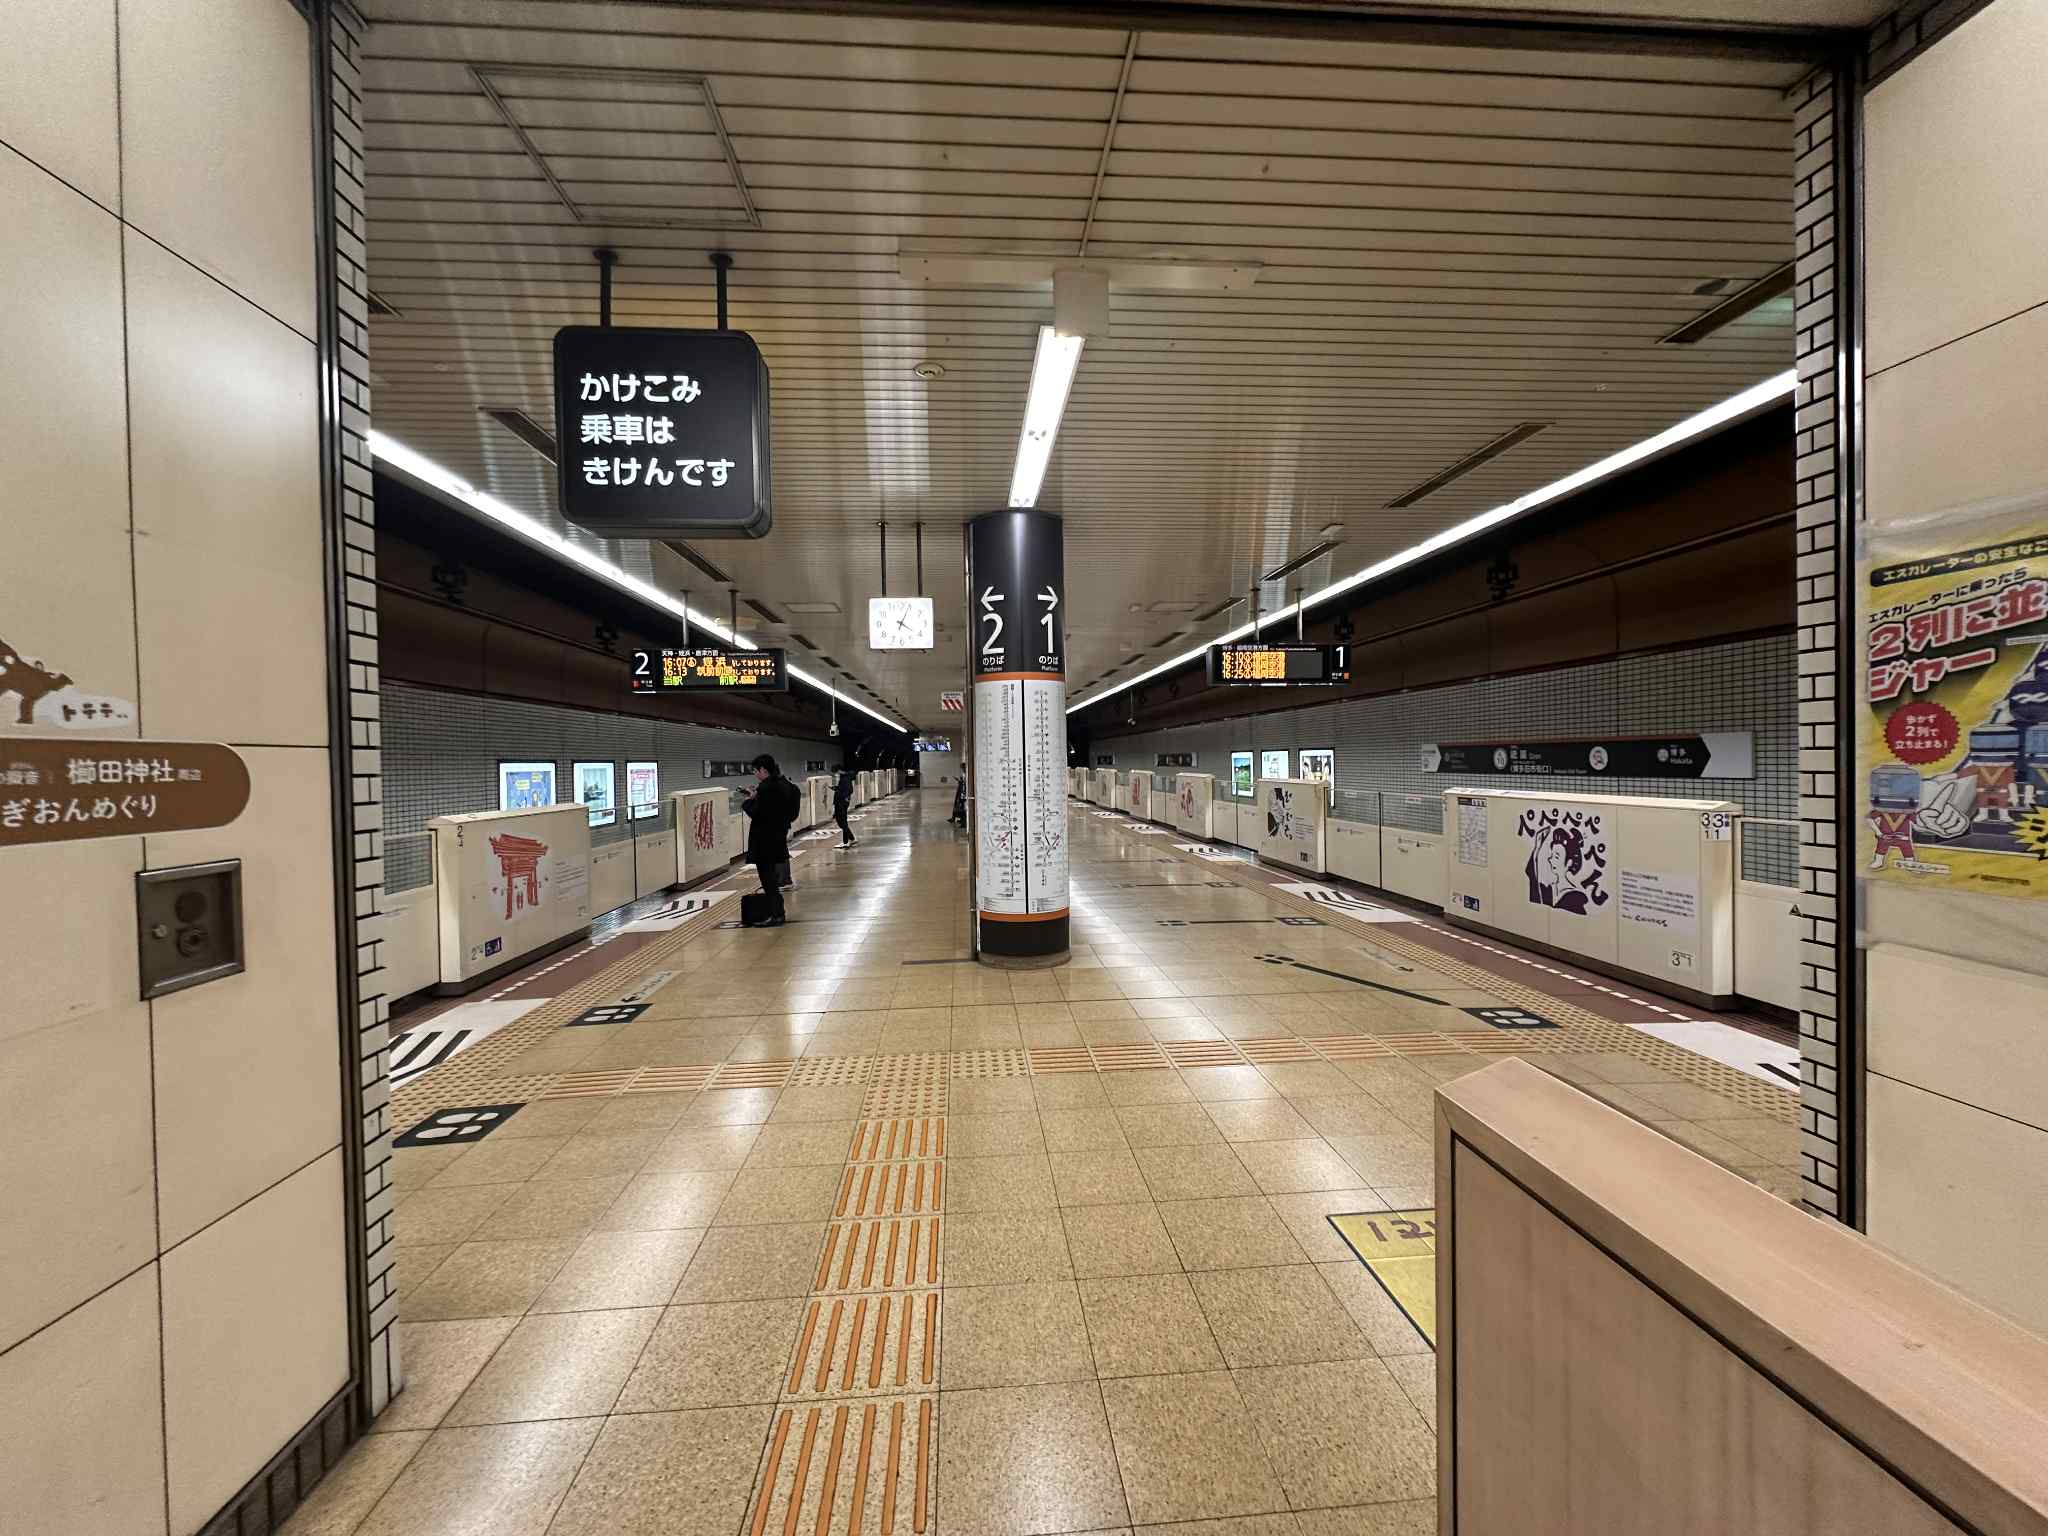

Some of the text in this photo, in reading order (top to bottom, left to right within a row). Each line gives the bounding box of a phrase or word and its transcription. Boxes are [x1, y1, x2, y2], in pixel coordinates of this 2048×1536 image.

[580, 372, 702, 404] かけこみ
[580, 413, 677, 445] 乗車は
[582, 456, 736, 487] きけんです
[982, 613, 1005, 655] 2
[1040, 613, 1054, 653] 1
[634, 652, 650, 675] 2
[663, 657, 687, 667] 16:07
[982, 655, 1005, 665] のりば
[1038, 655, 1059, 665] のりば
[1335, 646, 1344, 668] 1
[663, 667, 688, 677] 16:13
[1869, 647, 1997, 703] ジャー
[66, 757, 176, 784] 櫛田神社
[1, 794, 157, 828] ぎおんめぐり
[1712, 813, 1724, 828] 3
[1714, 829, 1721, 840] 1
[1671, 952, 1681, 967] 3
